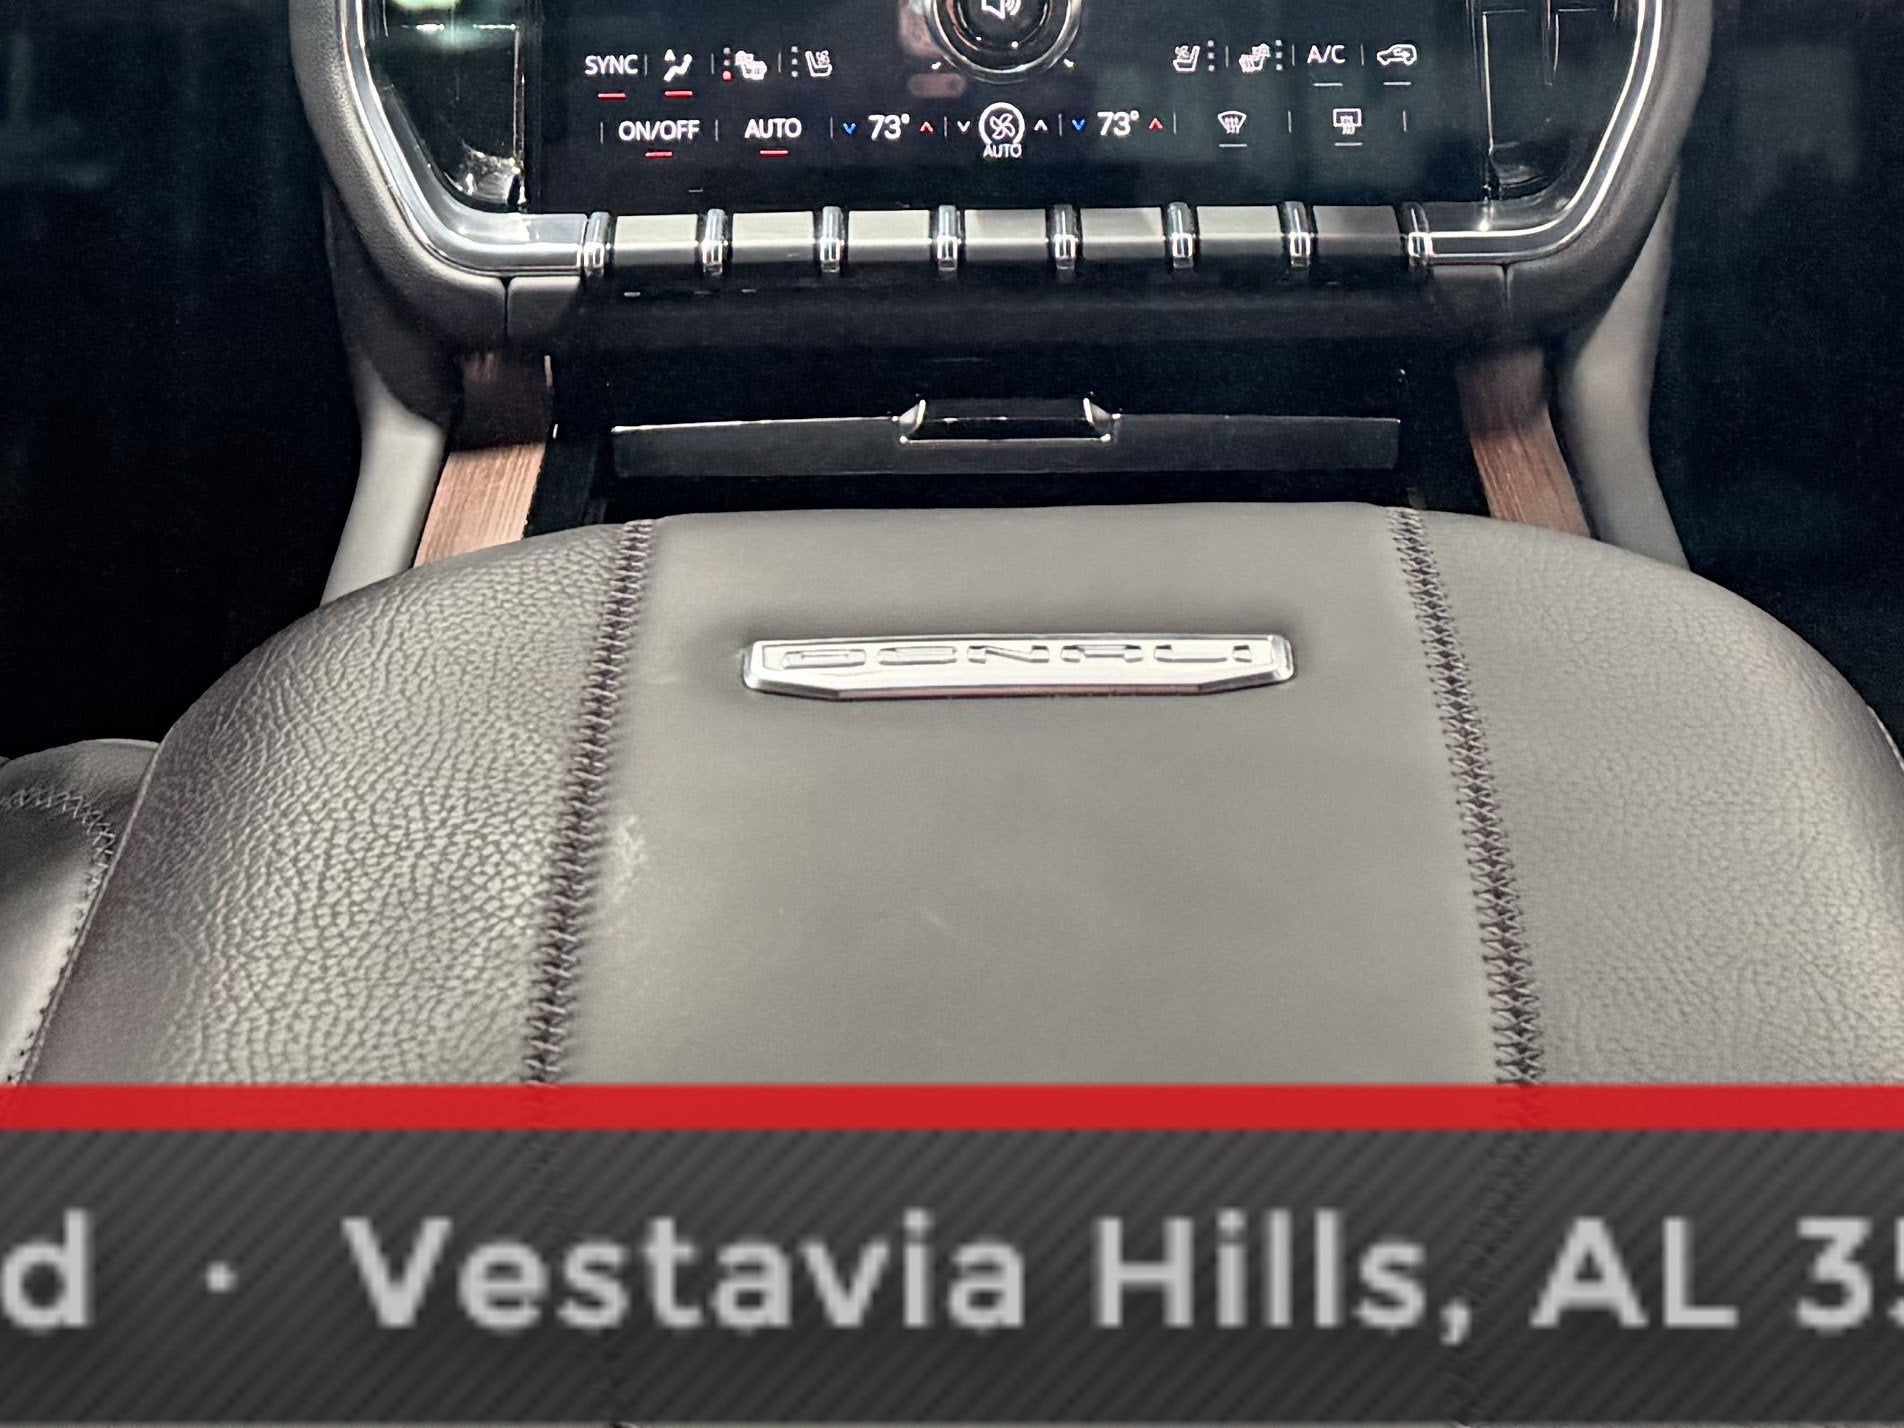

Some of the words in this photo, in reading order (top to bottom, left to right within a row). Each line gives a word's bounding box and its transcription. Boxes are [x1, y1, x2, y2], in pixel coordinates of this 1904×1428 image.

[1307, 45, 1346, 64] A/C
[584, 55, 639, 76] SYNC
[618, 119, 700, 141] ON/OFF
[744, 118, 802, 139] AUTO
[868, 113, 910, 141] 73°
[1097, 110, 1139, 138] 73°
[983, 142, 1022, 159] AUTO
